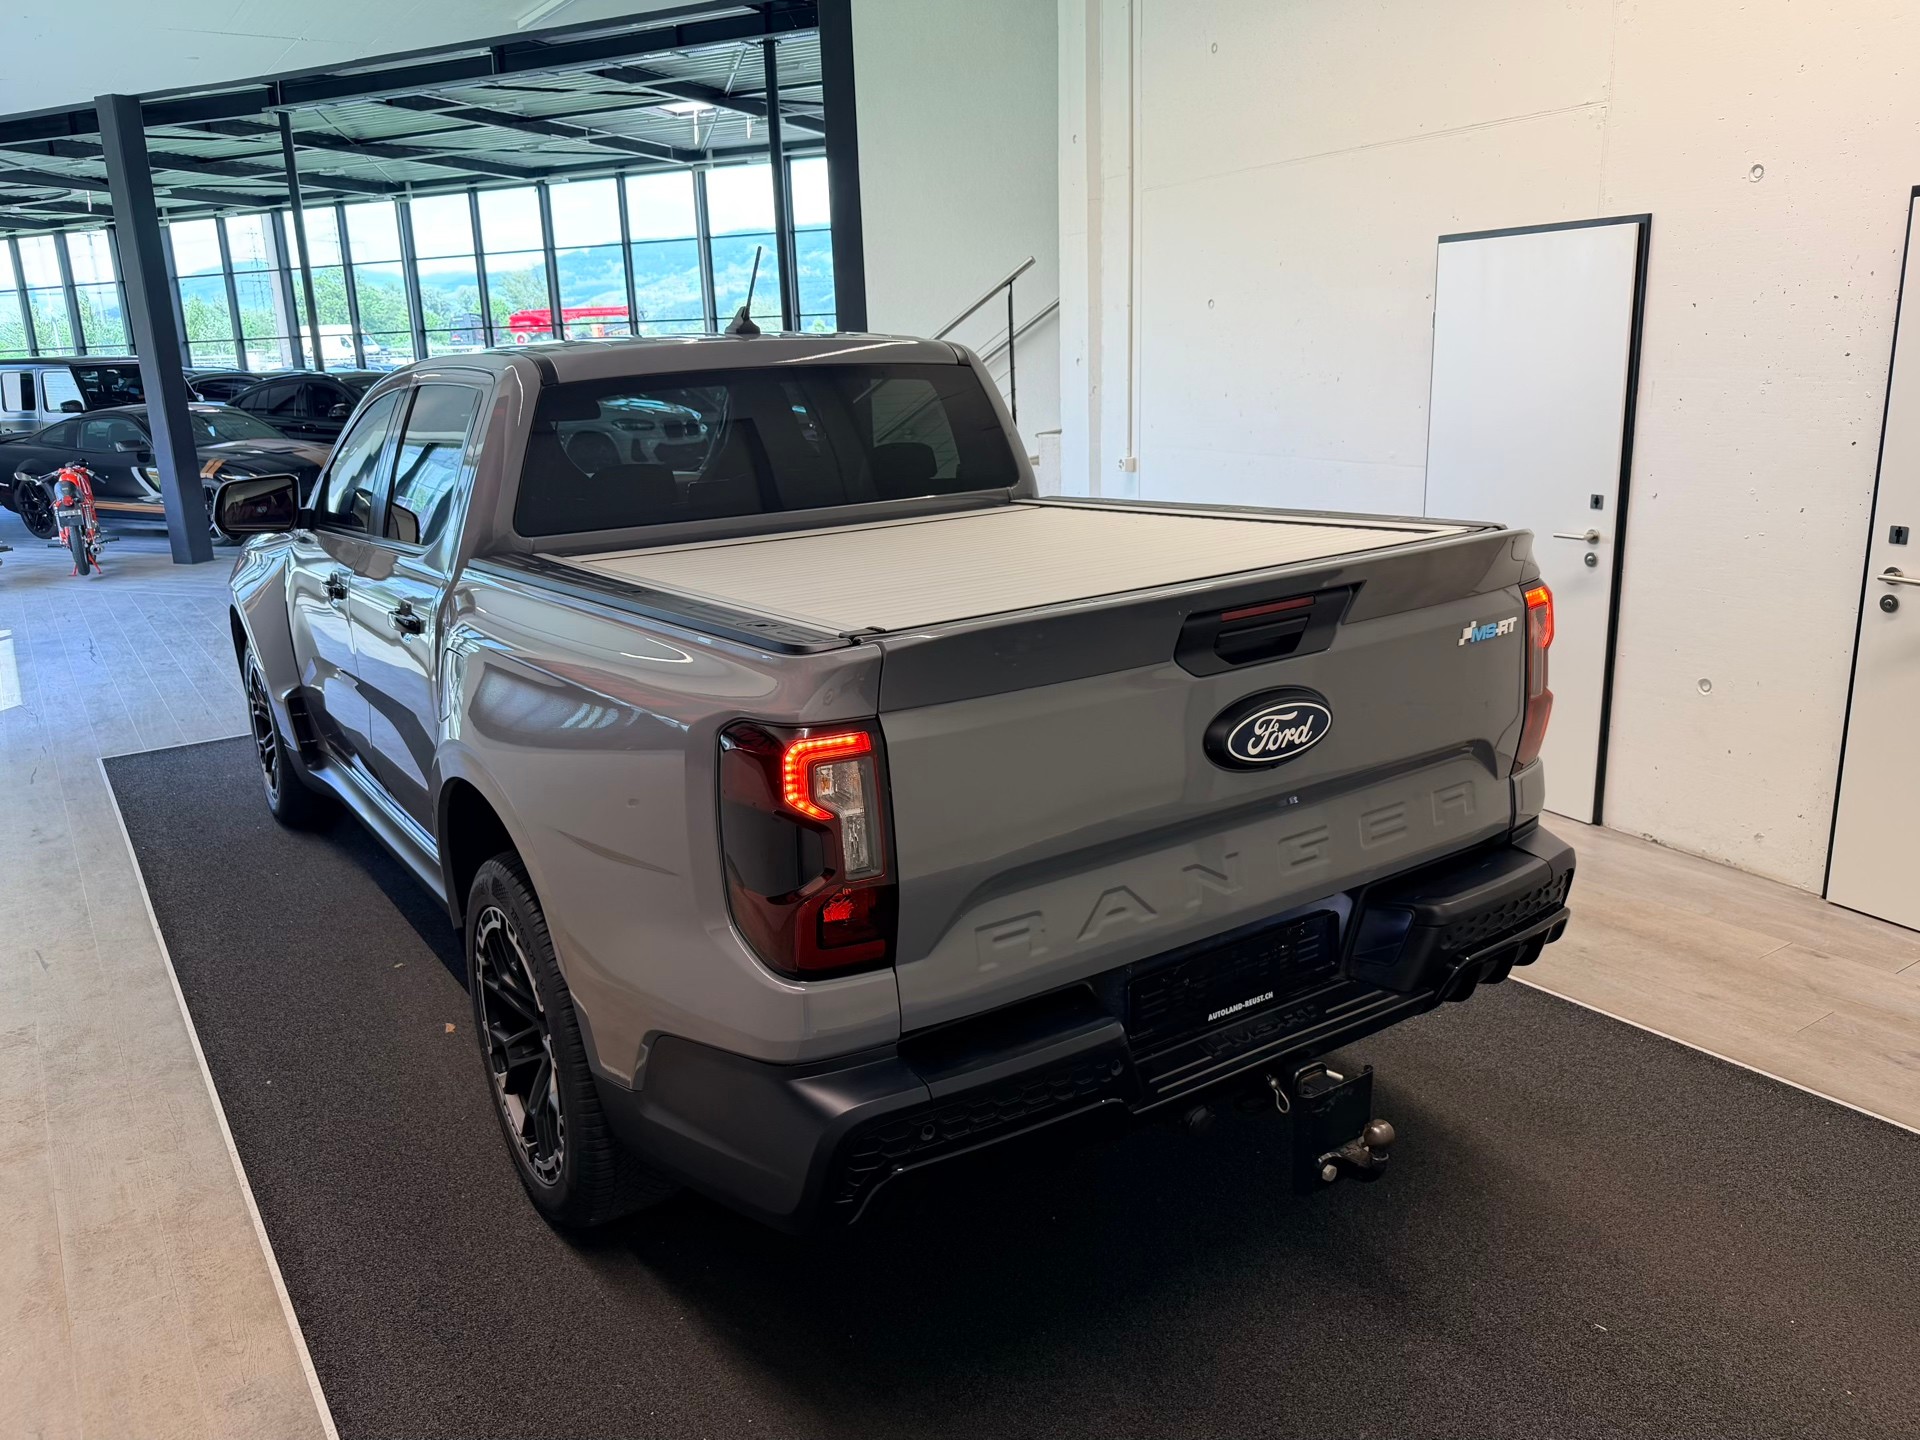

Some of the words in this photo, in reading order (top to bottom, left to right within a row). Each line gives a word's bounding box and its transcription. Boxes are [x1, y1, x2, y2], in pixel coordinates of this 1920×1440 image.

[1247, 711, 1314, 755] Ford
[974, 779, 1476, 972] RANGER
[1207, 991, 1274, 1021] AUTOLAND-REUST.CH
